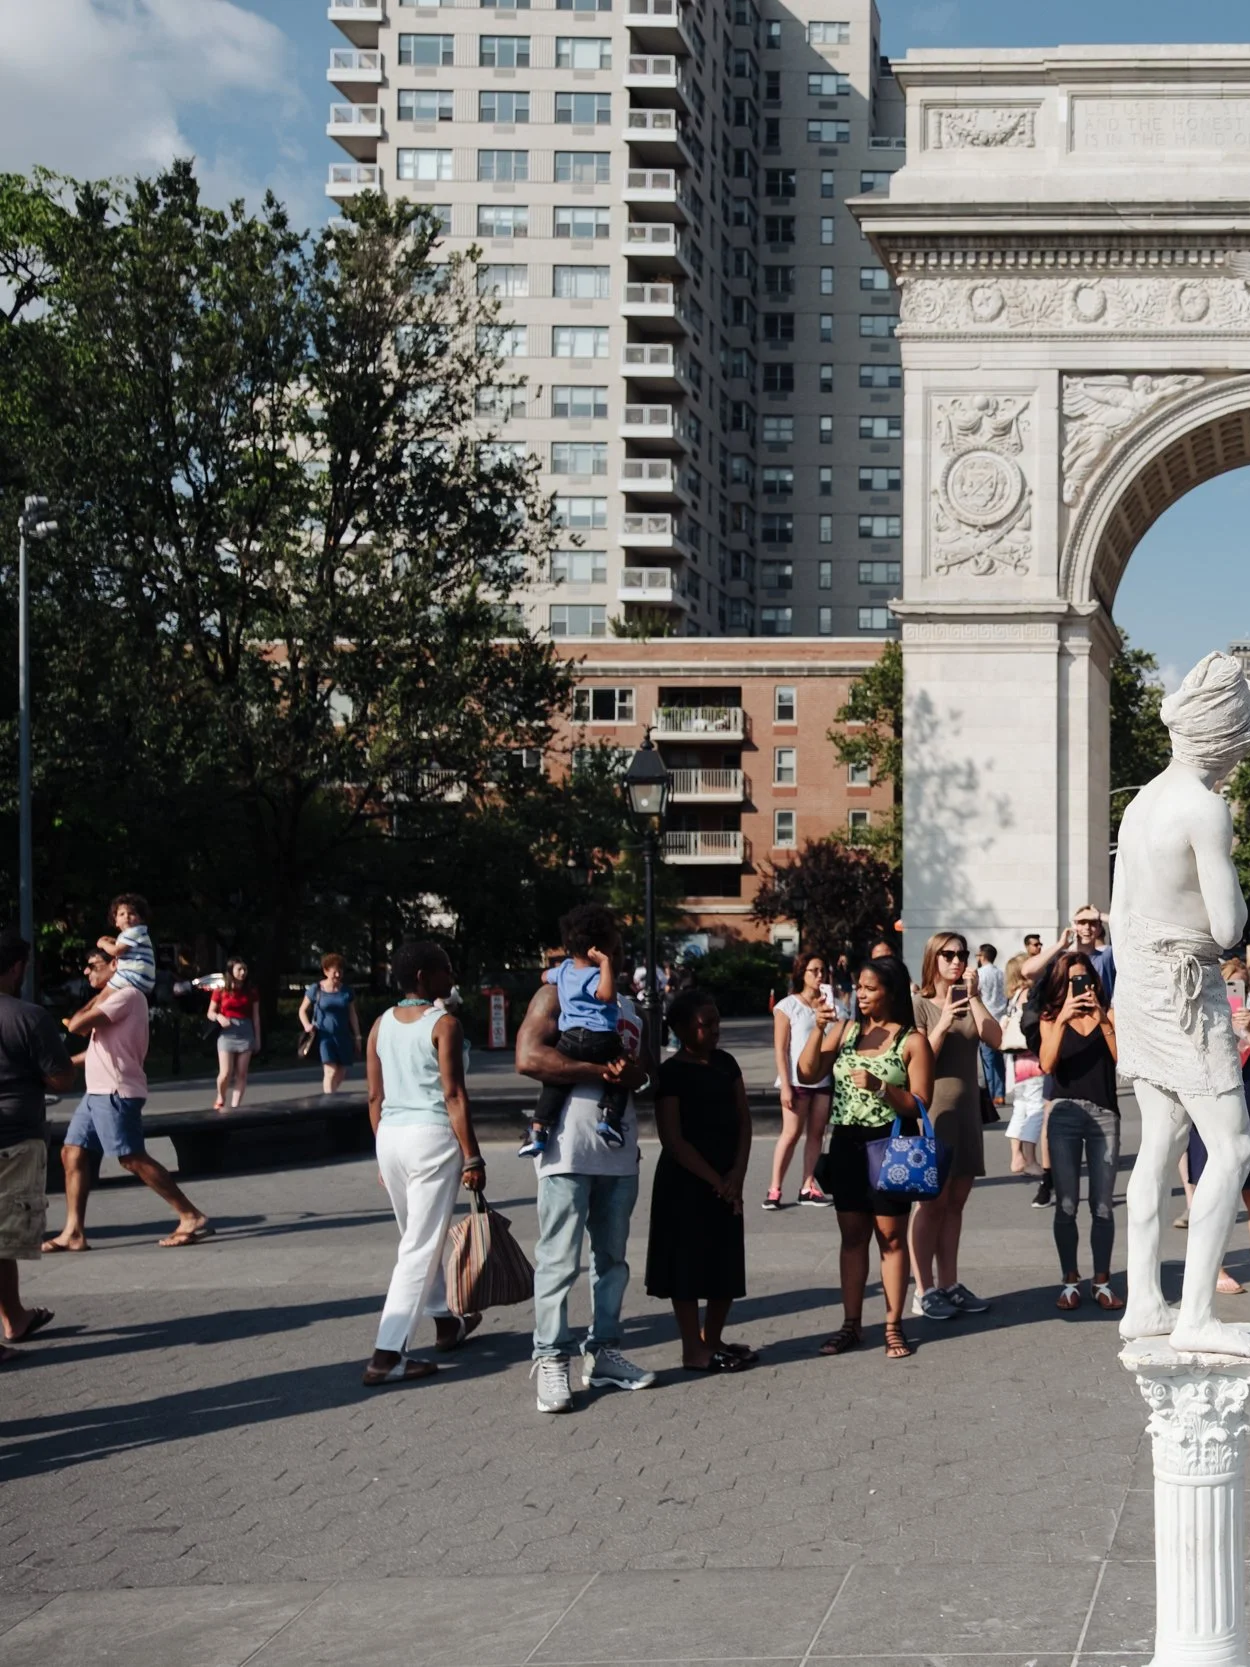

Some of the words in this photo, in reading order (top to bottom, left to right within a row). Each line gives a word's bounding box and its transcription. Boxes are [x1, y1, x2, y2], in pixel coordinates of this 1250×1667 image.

[1085, 102, 1116, 116] LET
[1123, 102, 1142, 116] US
[1147, 102, 1199, 116] RAISE
[1203, 102, 1215, 116] A
[1085, 117, 1120, 131] AND
[1127, 117, 1163, 131] THE
[1171, 117, 1244, 131] HONEST
[1085, 132, 1098, 147] IS
[1105, 132, 1122, 146] IN
[1129, 132, 1166, 146] THE
[1174, 132, 1225, 146] HAND
